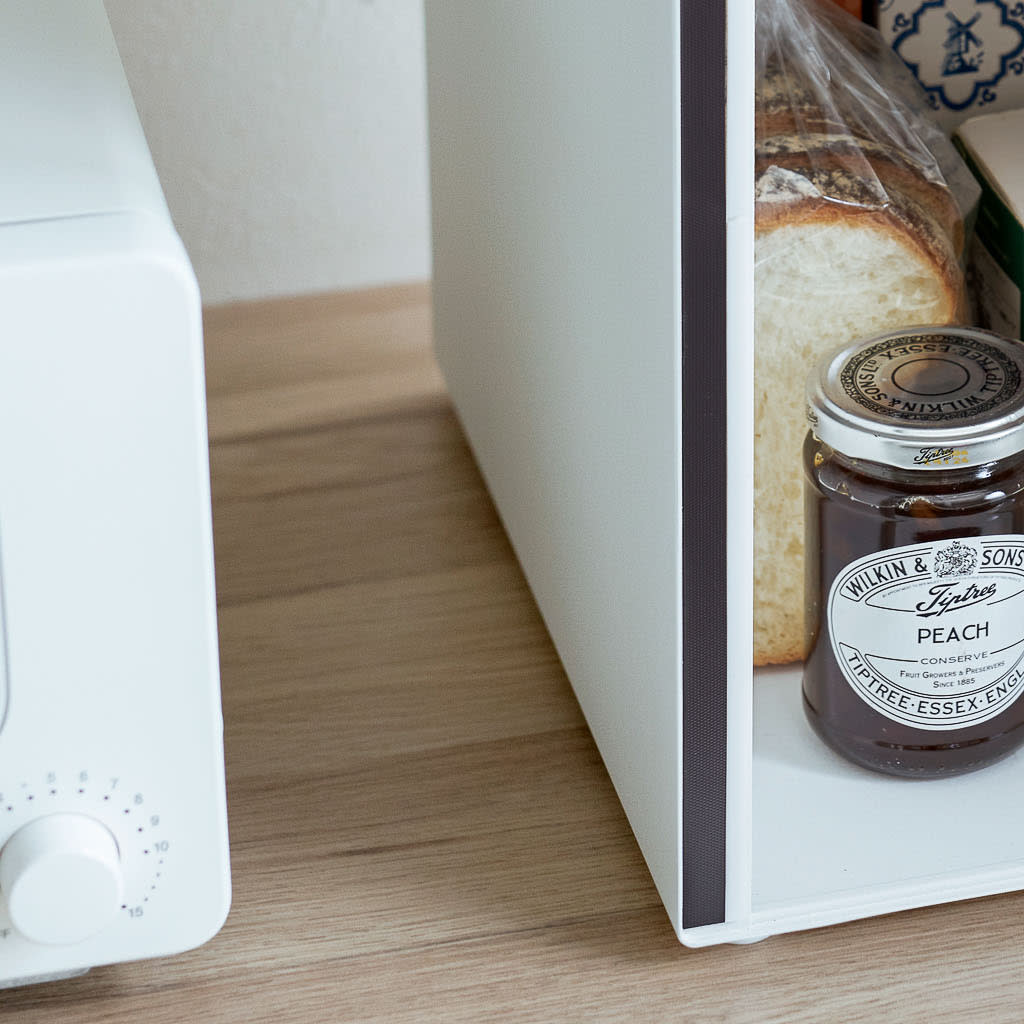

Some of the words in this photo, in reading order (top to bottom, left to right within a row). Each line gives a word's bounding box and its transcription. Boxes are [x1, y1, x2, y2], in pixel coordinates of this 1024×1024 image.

[879, 344, 951, 360] ESSEX
[958, 346, 1003, 393] TIPTREE
[859, 373, 888, 401] SONS
[888, 397, 900, 407] &
[900, 394, 985, 413] WILKIN
[845, 560, 908, 598] WILKIN
[914, 557, 928, 572] &
[981, 549, 1023, 566] SONS
[915, 582, 997, 617] Tiptree
[917, 621, 989, 644] PEACH
[920, 651, 988, 665] CONSERVE
[848, 652, 912, 710] TIPTREE
[917, 697, 978, 716] ESSEX
[957, 677, 976, 686] 1885
[111, 777, 120, 790] 7
[154, 840, 170, 853] 10
[128, 906, 144, 918] 15
